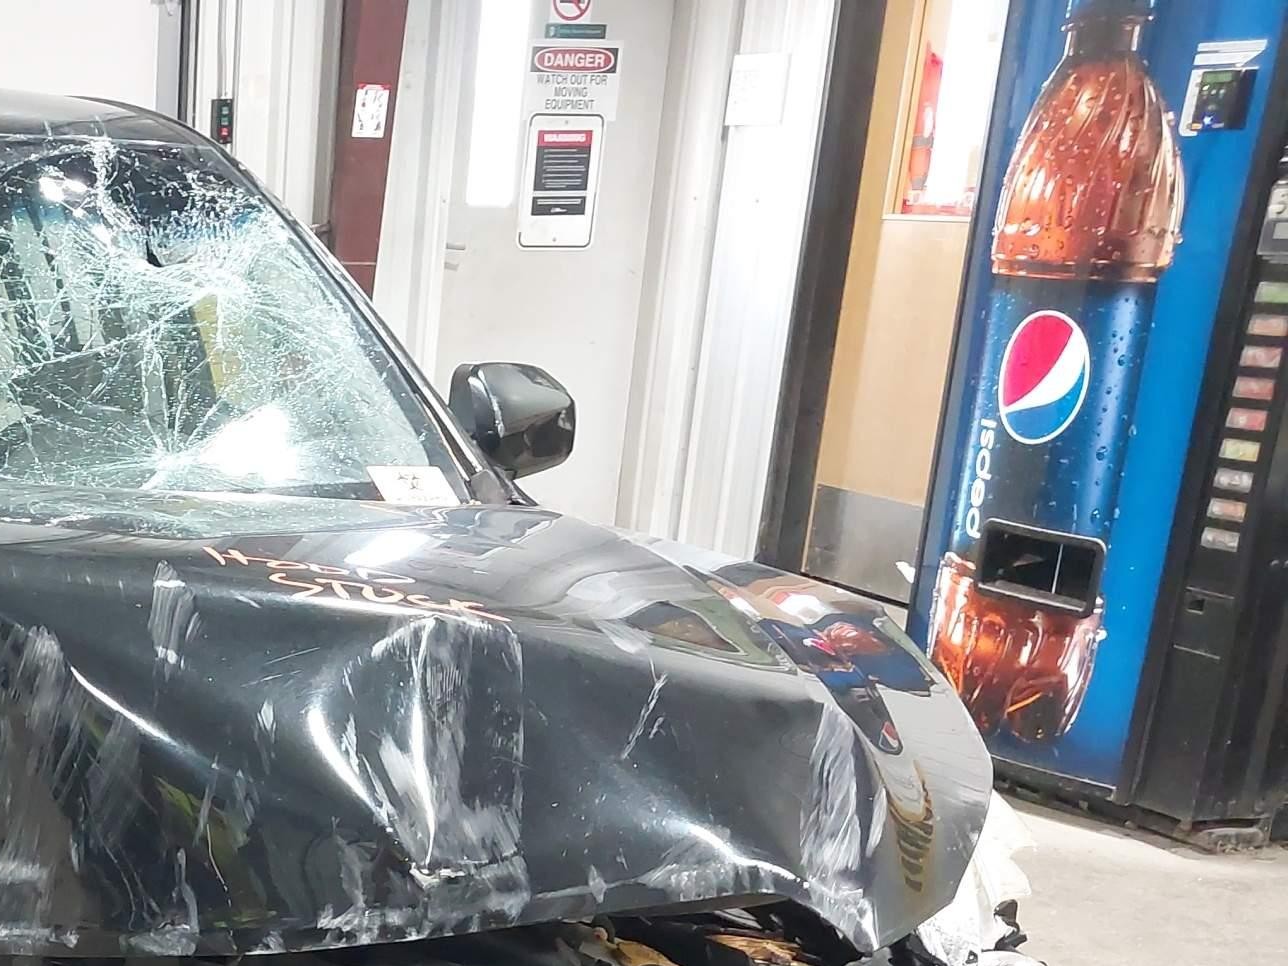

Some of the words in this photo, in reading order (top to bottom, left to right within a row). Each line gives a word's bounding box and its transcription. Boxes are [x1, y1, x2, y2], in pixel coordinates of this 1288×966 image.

[543, 53, 606, 68] DANGER
[536, 74, 568, 85] WATCH
[570, 74, 588, 85] OUT
[590, 75, 608, 86] FOR
[554, 86, 588, 97] MOVING
[544, 98, 595, 110] EQUIPMENT
[965, 418, 997, 539] pepsi
